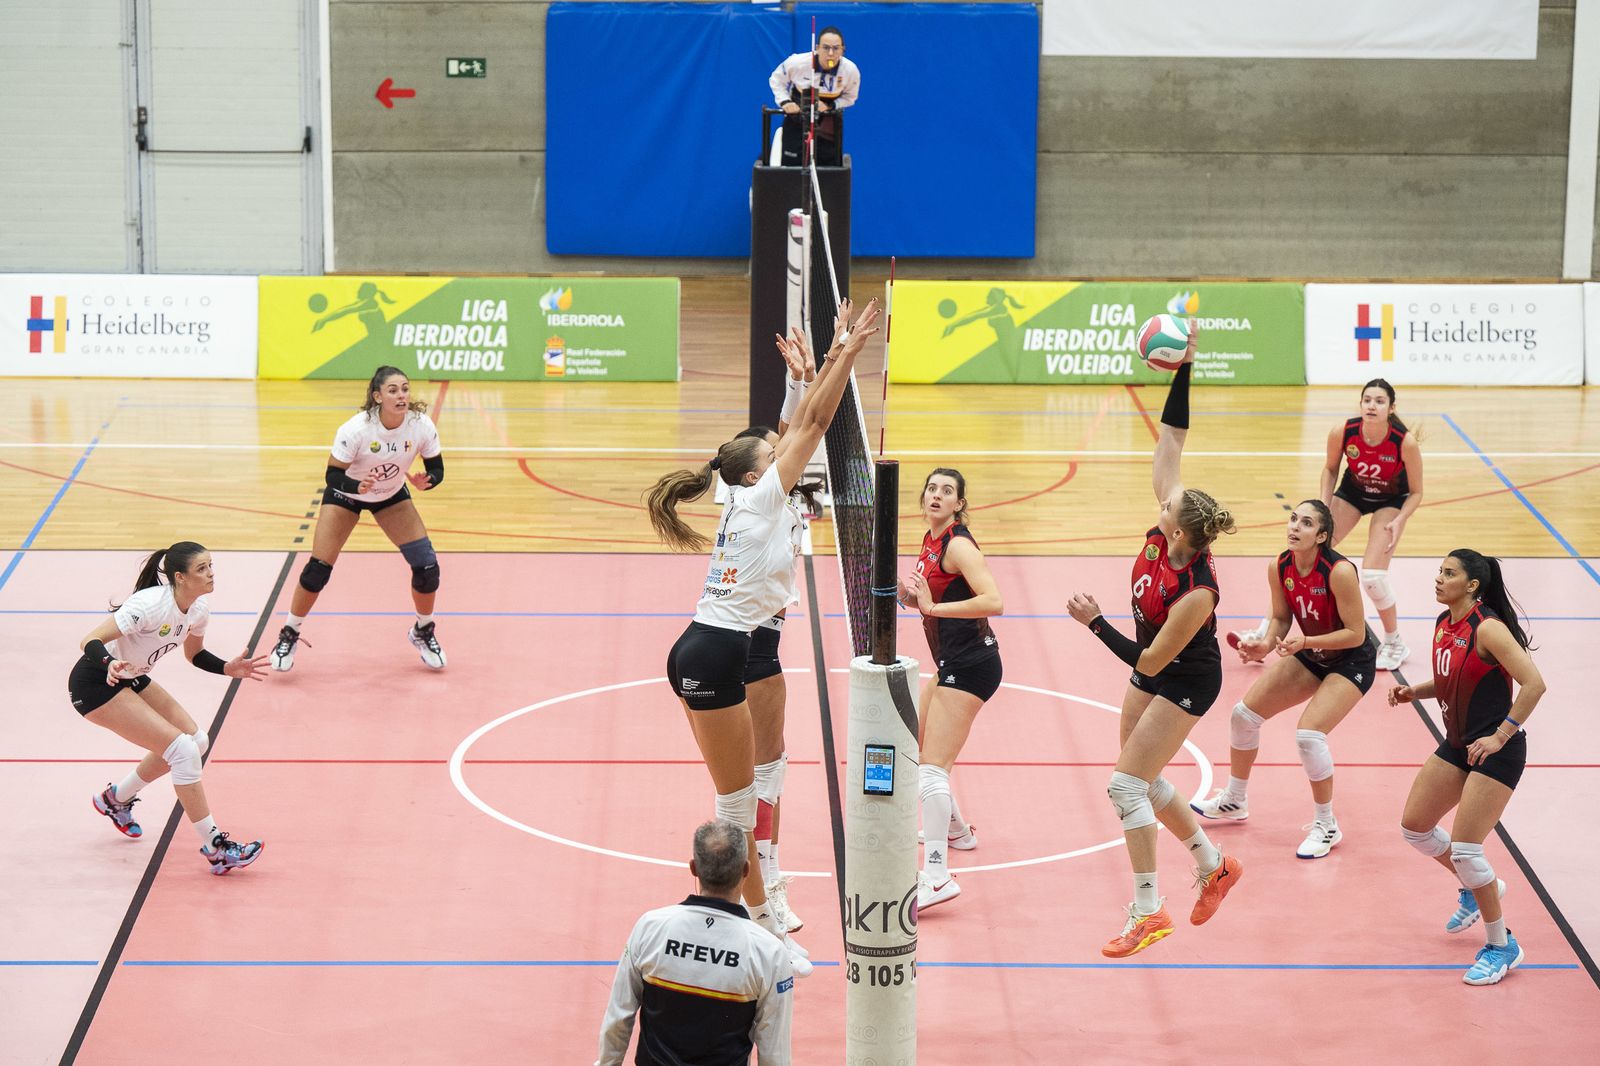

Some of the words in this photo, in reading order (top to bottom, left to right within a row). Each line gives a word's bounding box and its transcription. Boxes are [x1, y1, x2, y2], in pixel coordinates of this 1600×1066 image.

[82, 295, 212, 307] COLEGIO
[461, 299, 508, 322] LIGA
[1408, 303, 1537, 314] COLEGIO
[547, 314, 625, 327] IBERDROLA
[1090, 303, 1137, 326] LIGA
[81, 313, 212, 343] Heidelberg
[393, 324, 508, 347] IBERDROLA
[1023, 328, 1137, 351] IBERDROLA
[1408, 320, 1537, 350] Heidelberg
[81, 345, 126, 355] GRAN
[135, 345, 210, 355] CANARIA
[416, 349, 505, 371] VOLEIBOL
[1408, 353, 1452, 362] GRAN
[1462, 353, 1536, 362] CANARIA
[1046, 354, 1134, 375] VOLEIBOL
[386, 442, 397, 453] 14
[1357, 461, 1381, 479] 22
[1133, 573, 1152, 599] 6
[1295, 595, 1320, 621] 14
[1435, 647, 1452, 677] 10
[664, 938, 741, 968] RFEVB
[867, 963, 905, 987] 105
